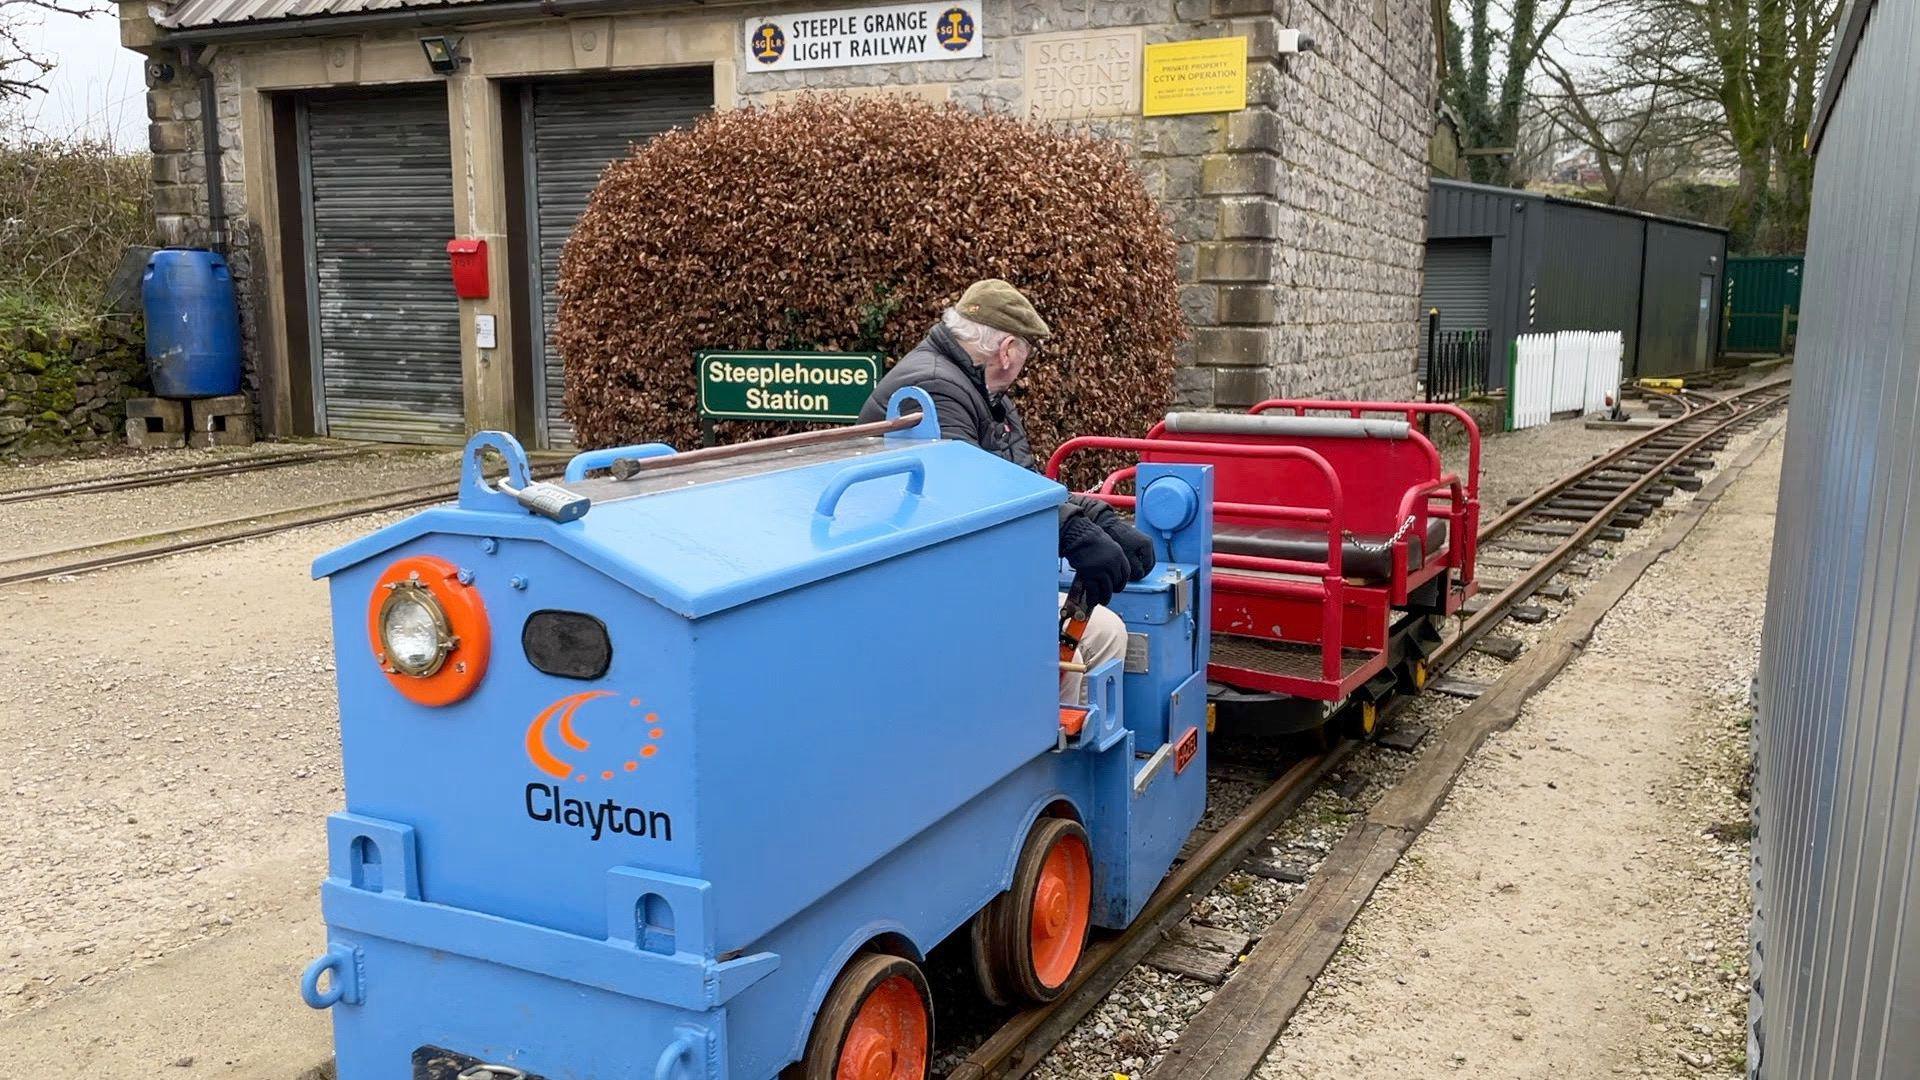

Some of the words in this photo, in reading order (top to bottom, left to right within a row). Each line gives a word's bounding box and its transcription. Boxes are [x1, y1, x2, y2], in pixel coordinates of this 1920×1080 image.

[793, 16, 857, 39] STEEPLE
[864, 11, 928, 34] GRANGE
[793, 41, 842, 62] LIGHT
[850, 35, 928, 58] RAILWAY
[1033, 61, 1131, 90] ENGINE
[1153, 74, 1176, 83] CCTV
[1178, 73, 1186, 81] IN
[1188, 70, 1237, 80] OPERATION
[1162, 64, 1189, 72] PRIVATE
[1191, 61, 1228, 70] PROPERTY
[1039, 84, 1125, 110] HOUSE
[709, 361, 868, 388] Steeplehouse
[746, 388, 829, 411] Station
[525, 783, 671, 841] Clayton
